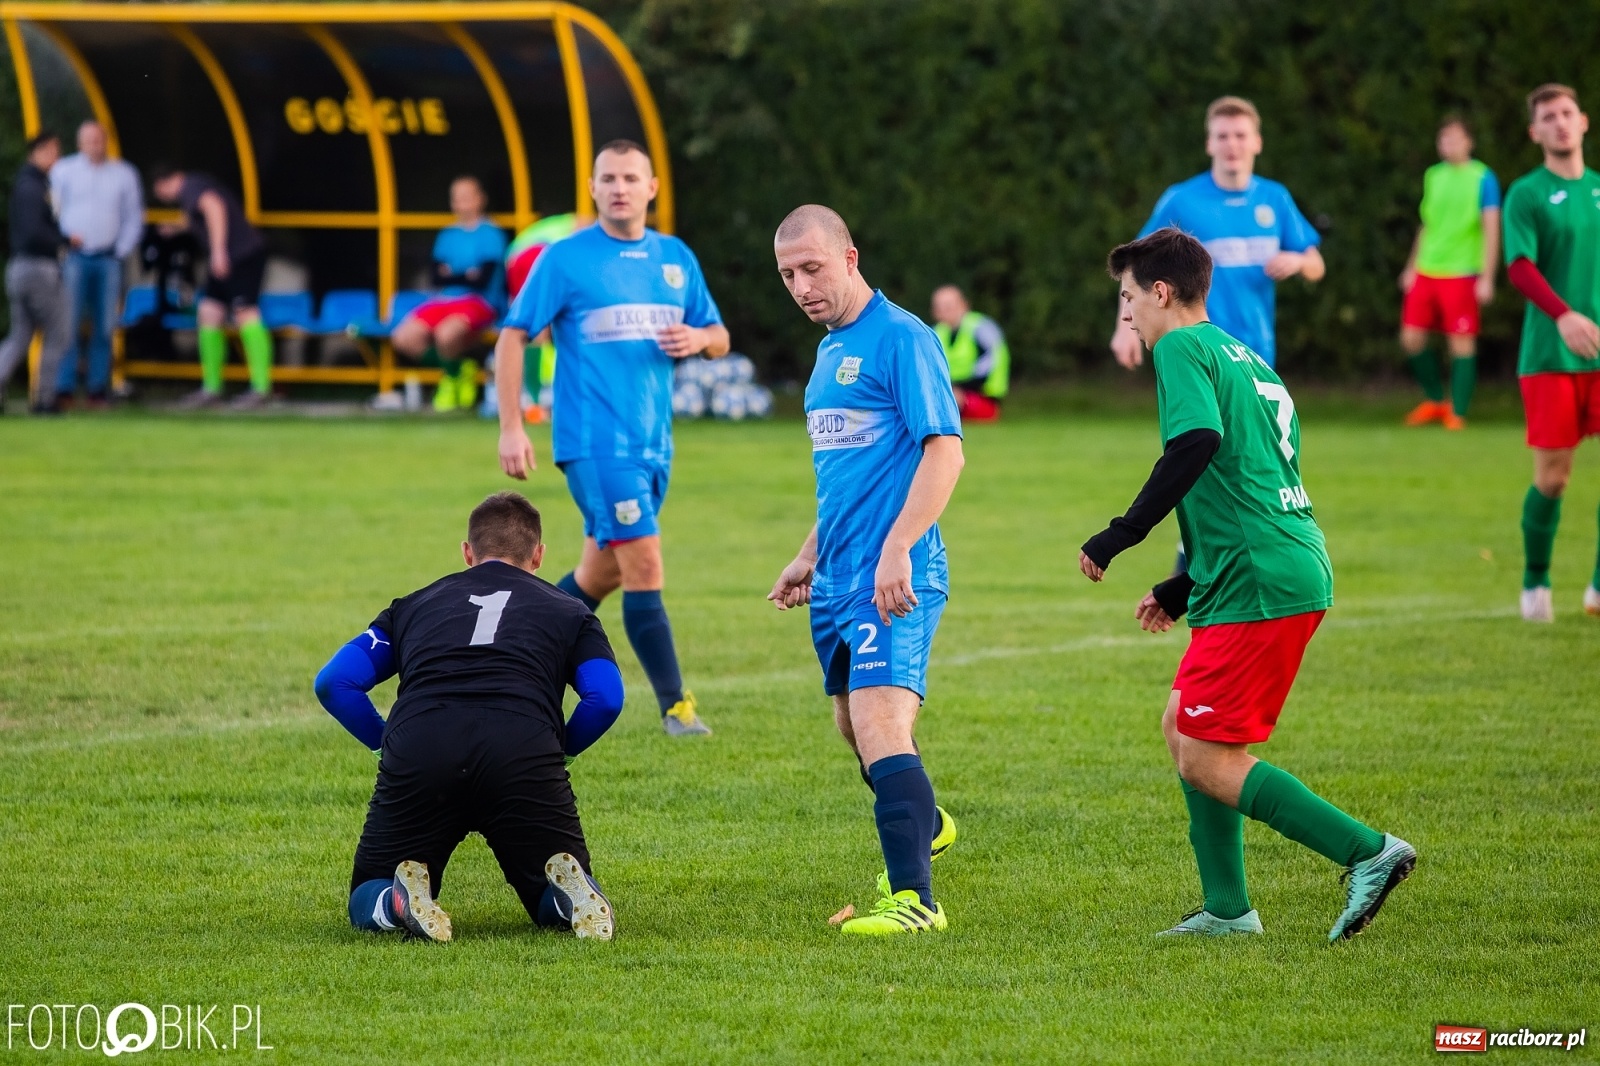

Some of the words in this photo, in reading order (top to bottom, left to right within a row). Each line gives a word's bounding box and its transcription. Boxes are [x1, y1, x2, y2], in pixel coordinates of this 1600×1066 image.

[1252, 376, 1295, 462] 7
[834, 435, 866, 444] HANDLOWE
[468, 590, 512, 646] 1
[857, 623, 878, 654] 2
[853, 661, 887, 671] regio
